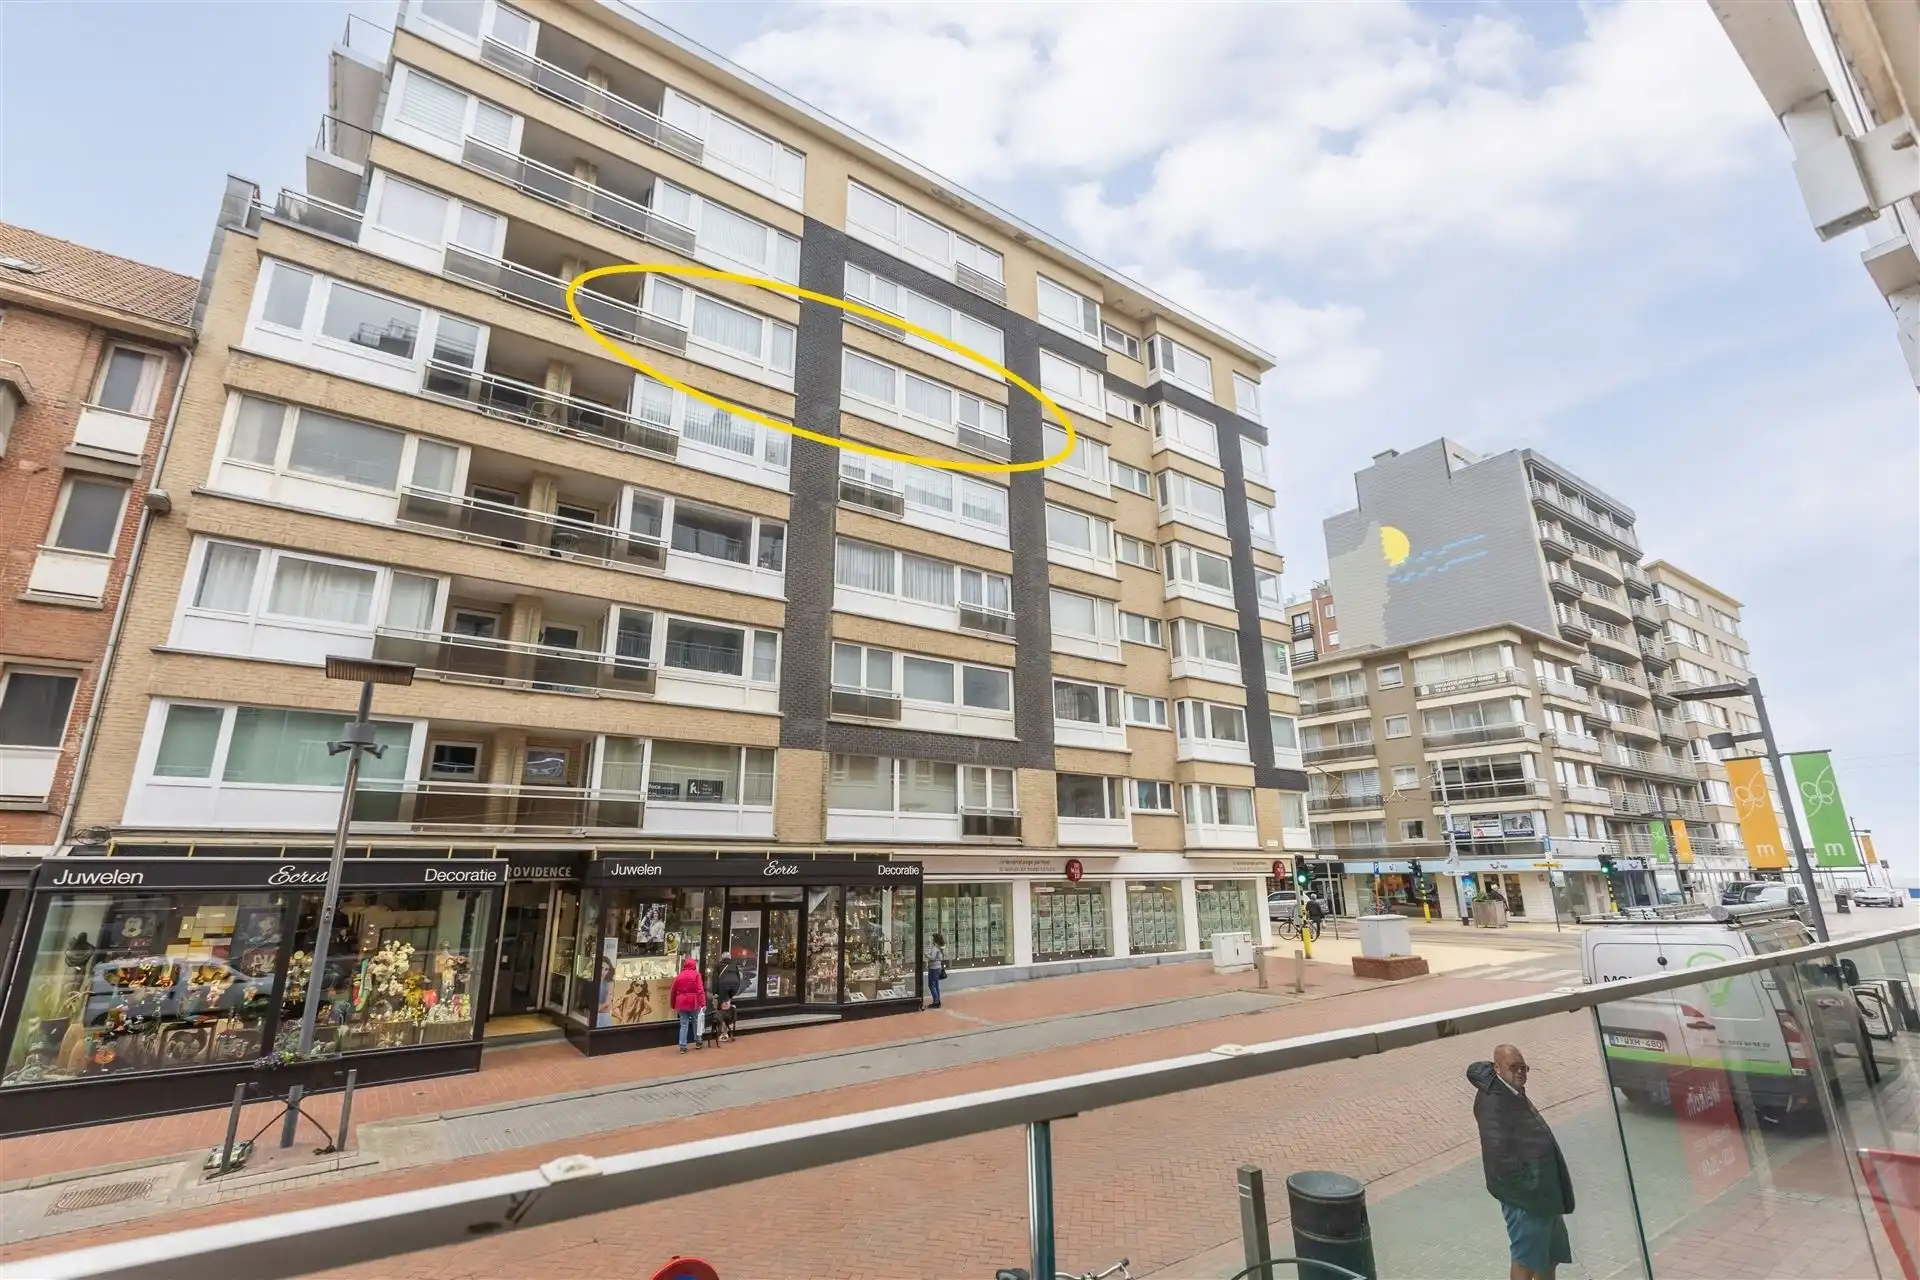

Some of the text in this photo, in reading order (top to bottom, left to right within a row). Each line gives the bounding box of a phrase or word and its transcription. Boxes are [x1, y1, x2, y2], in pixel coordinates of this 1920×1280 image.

[1756, 844, 1776, 857] m
[1824, 842, 1846, 857] m
[268, 865, 329, 885] Ecris
[425, 868, 497, 882] Decoratie
[507, 866, 572, 877] ROVIDENCE
[611, 863, 662, 875] Juwelen
[763, 860, 799, 876] Ecris
[878, 865, 920, 876] Decoratie
[53, 869, 144, 885] Juwelen
